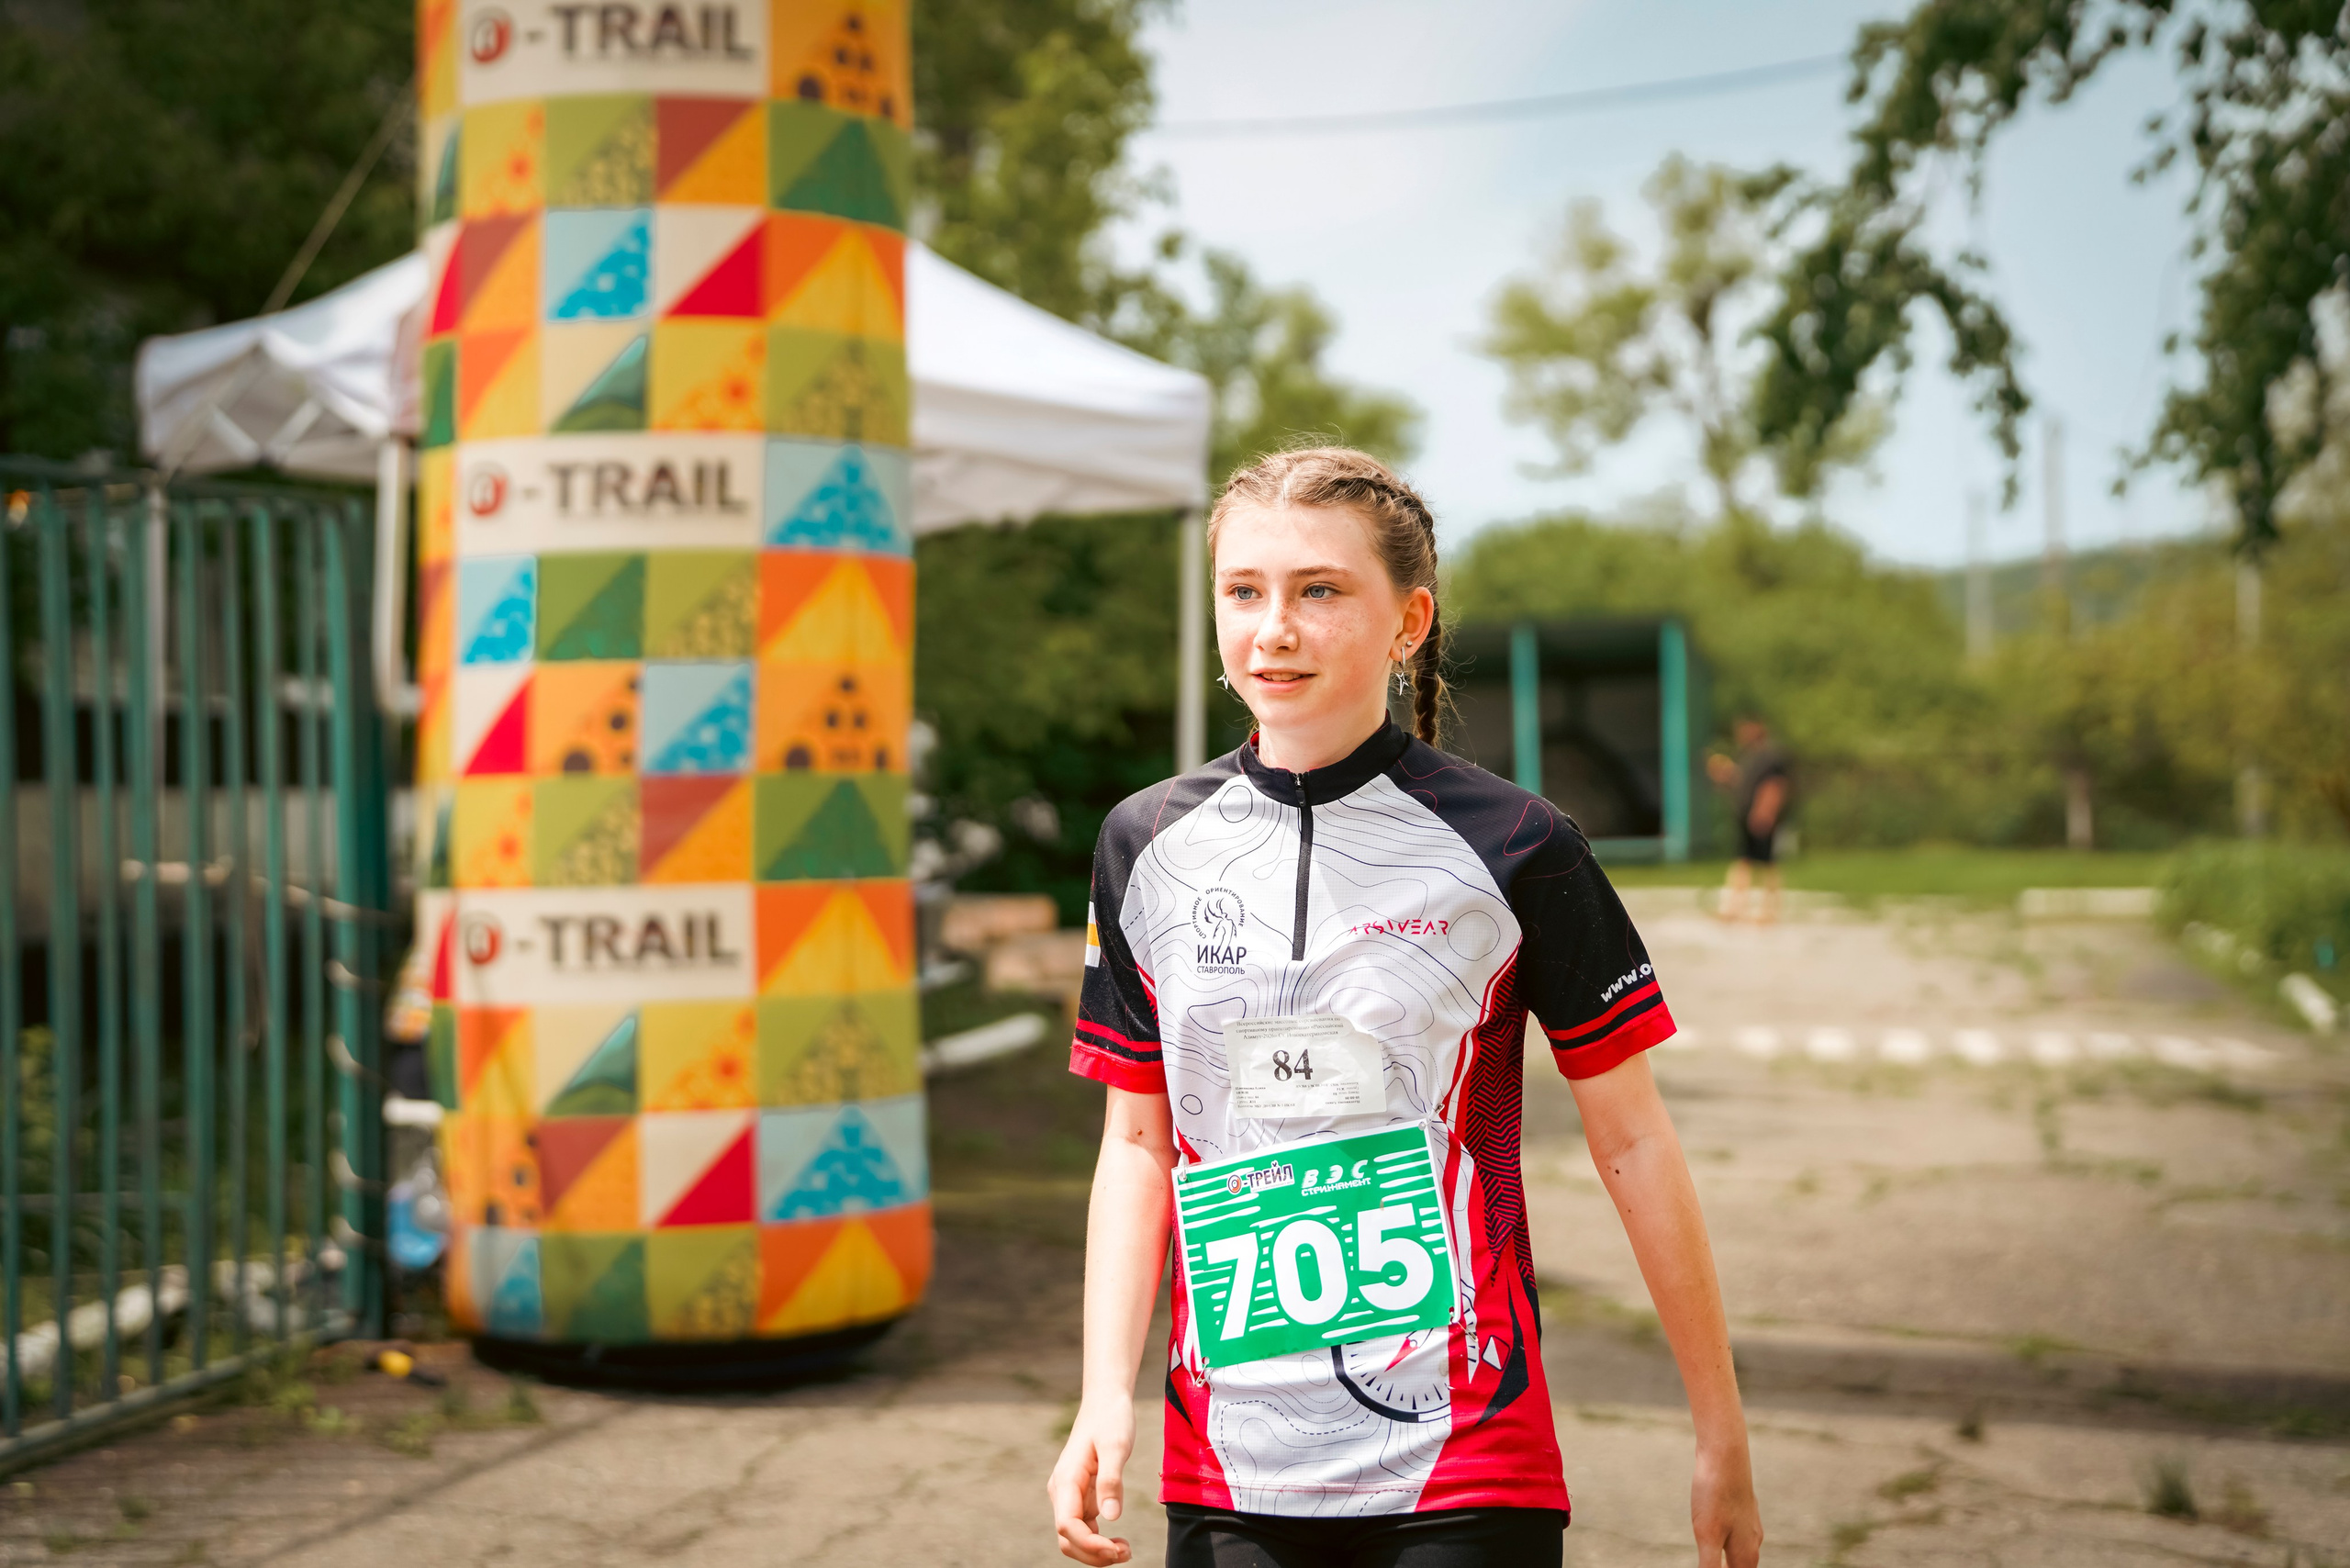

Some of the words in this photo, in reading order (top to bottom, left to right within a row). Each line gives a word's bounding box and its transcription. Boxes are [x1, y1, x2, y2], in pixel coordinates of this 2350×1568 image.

[1192, 897, 1207, 939] СПОРТИВНОЕ
[1205, 887, 1246, 927] ОРИЕНТИРОВАНИЕ
[1197, 945, 1247, 965] ИКАР
[1197, 966, 1245, 975] СТАВРОПОЛЬ
[1272, 1048, 1313, 1081] 84
[1301, 1178, 1371, 1196] СТРИЖАМЕНТ
[1205, 1203, 1434, 1341] 705
